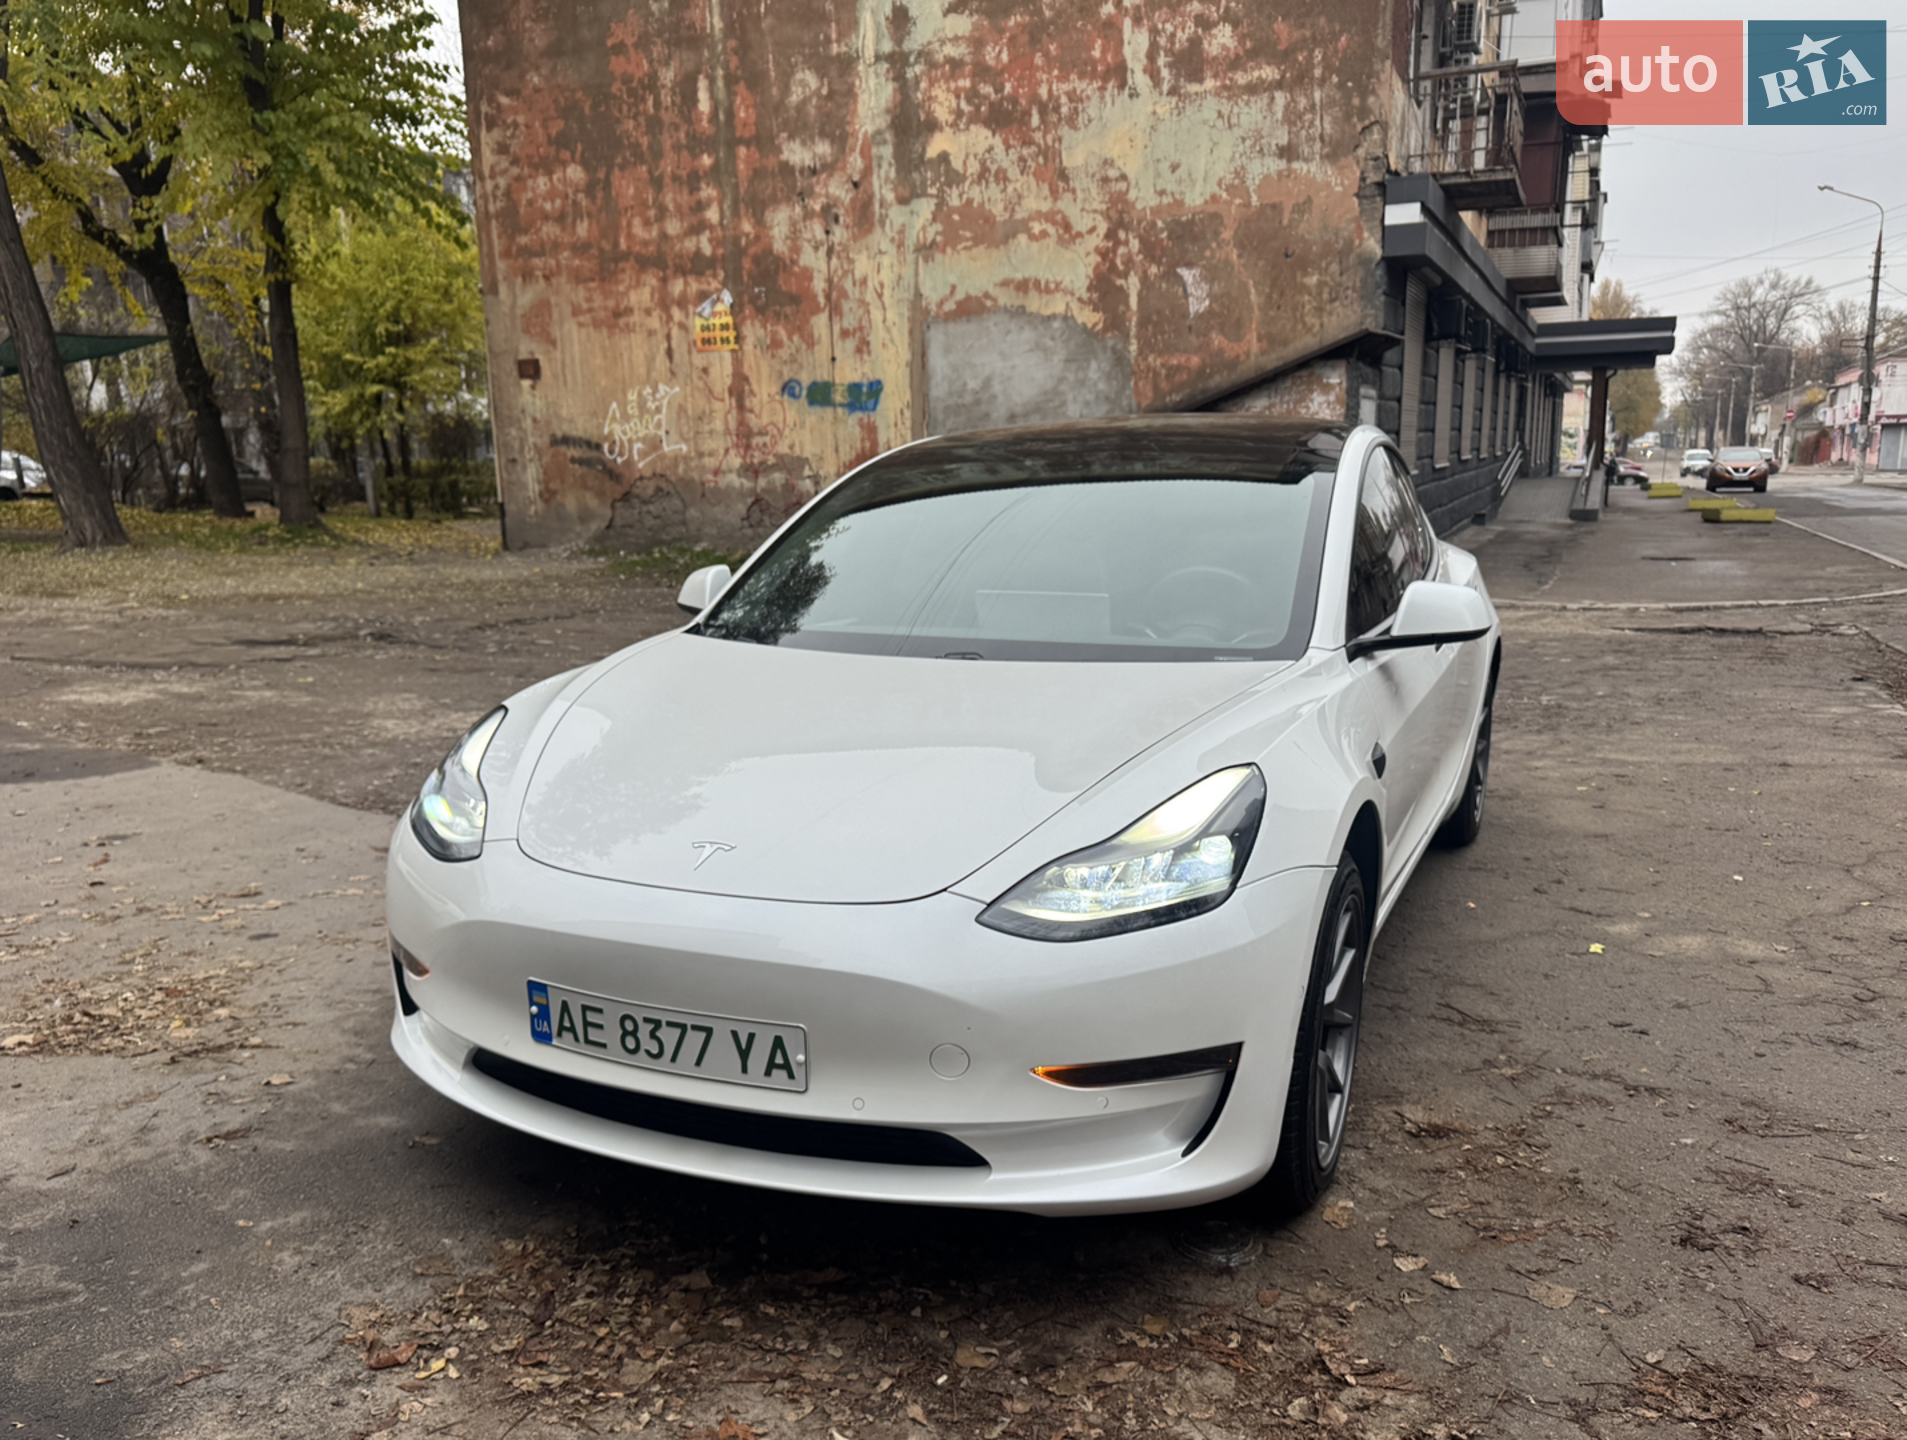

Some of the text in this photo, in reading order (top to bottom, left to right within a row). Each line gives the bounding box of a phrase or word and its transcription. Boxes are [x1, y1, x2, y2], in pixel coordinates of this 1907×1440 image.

[534, 1018, 550, 1034] UA
[556, 999, 796, 1081] AE 8377 YA
